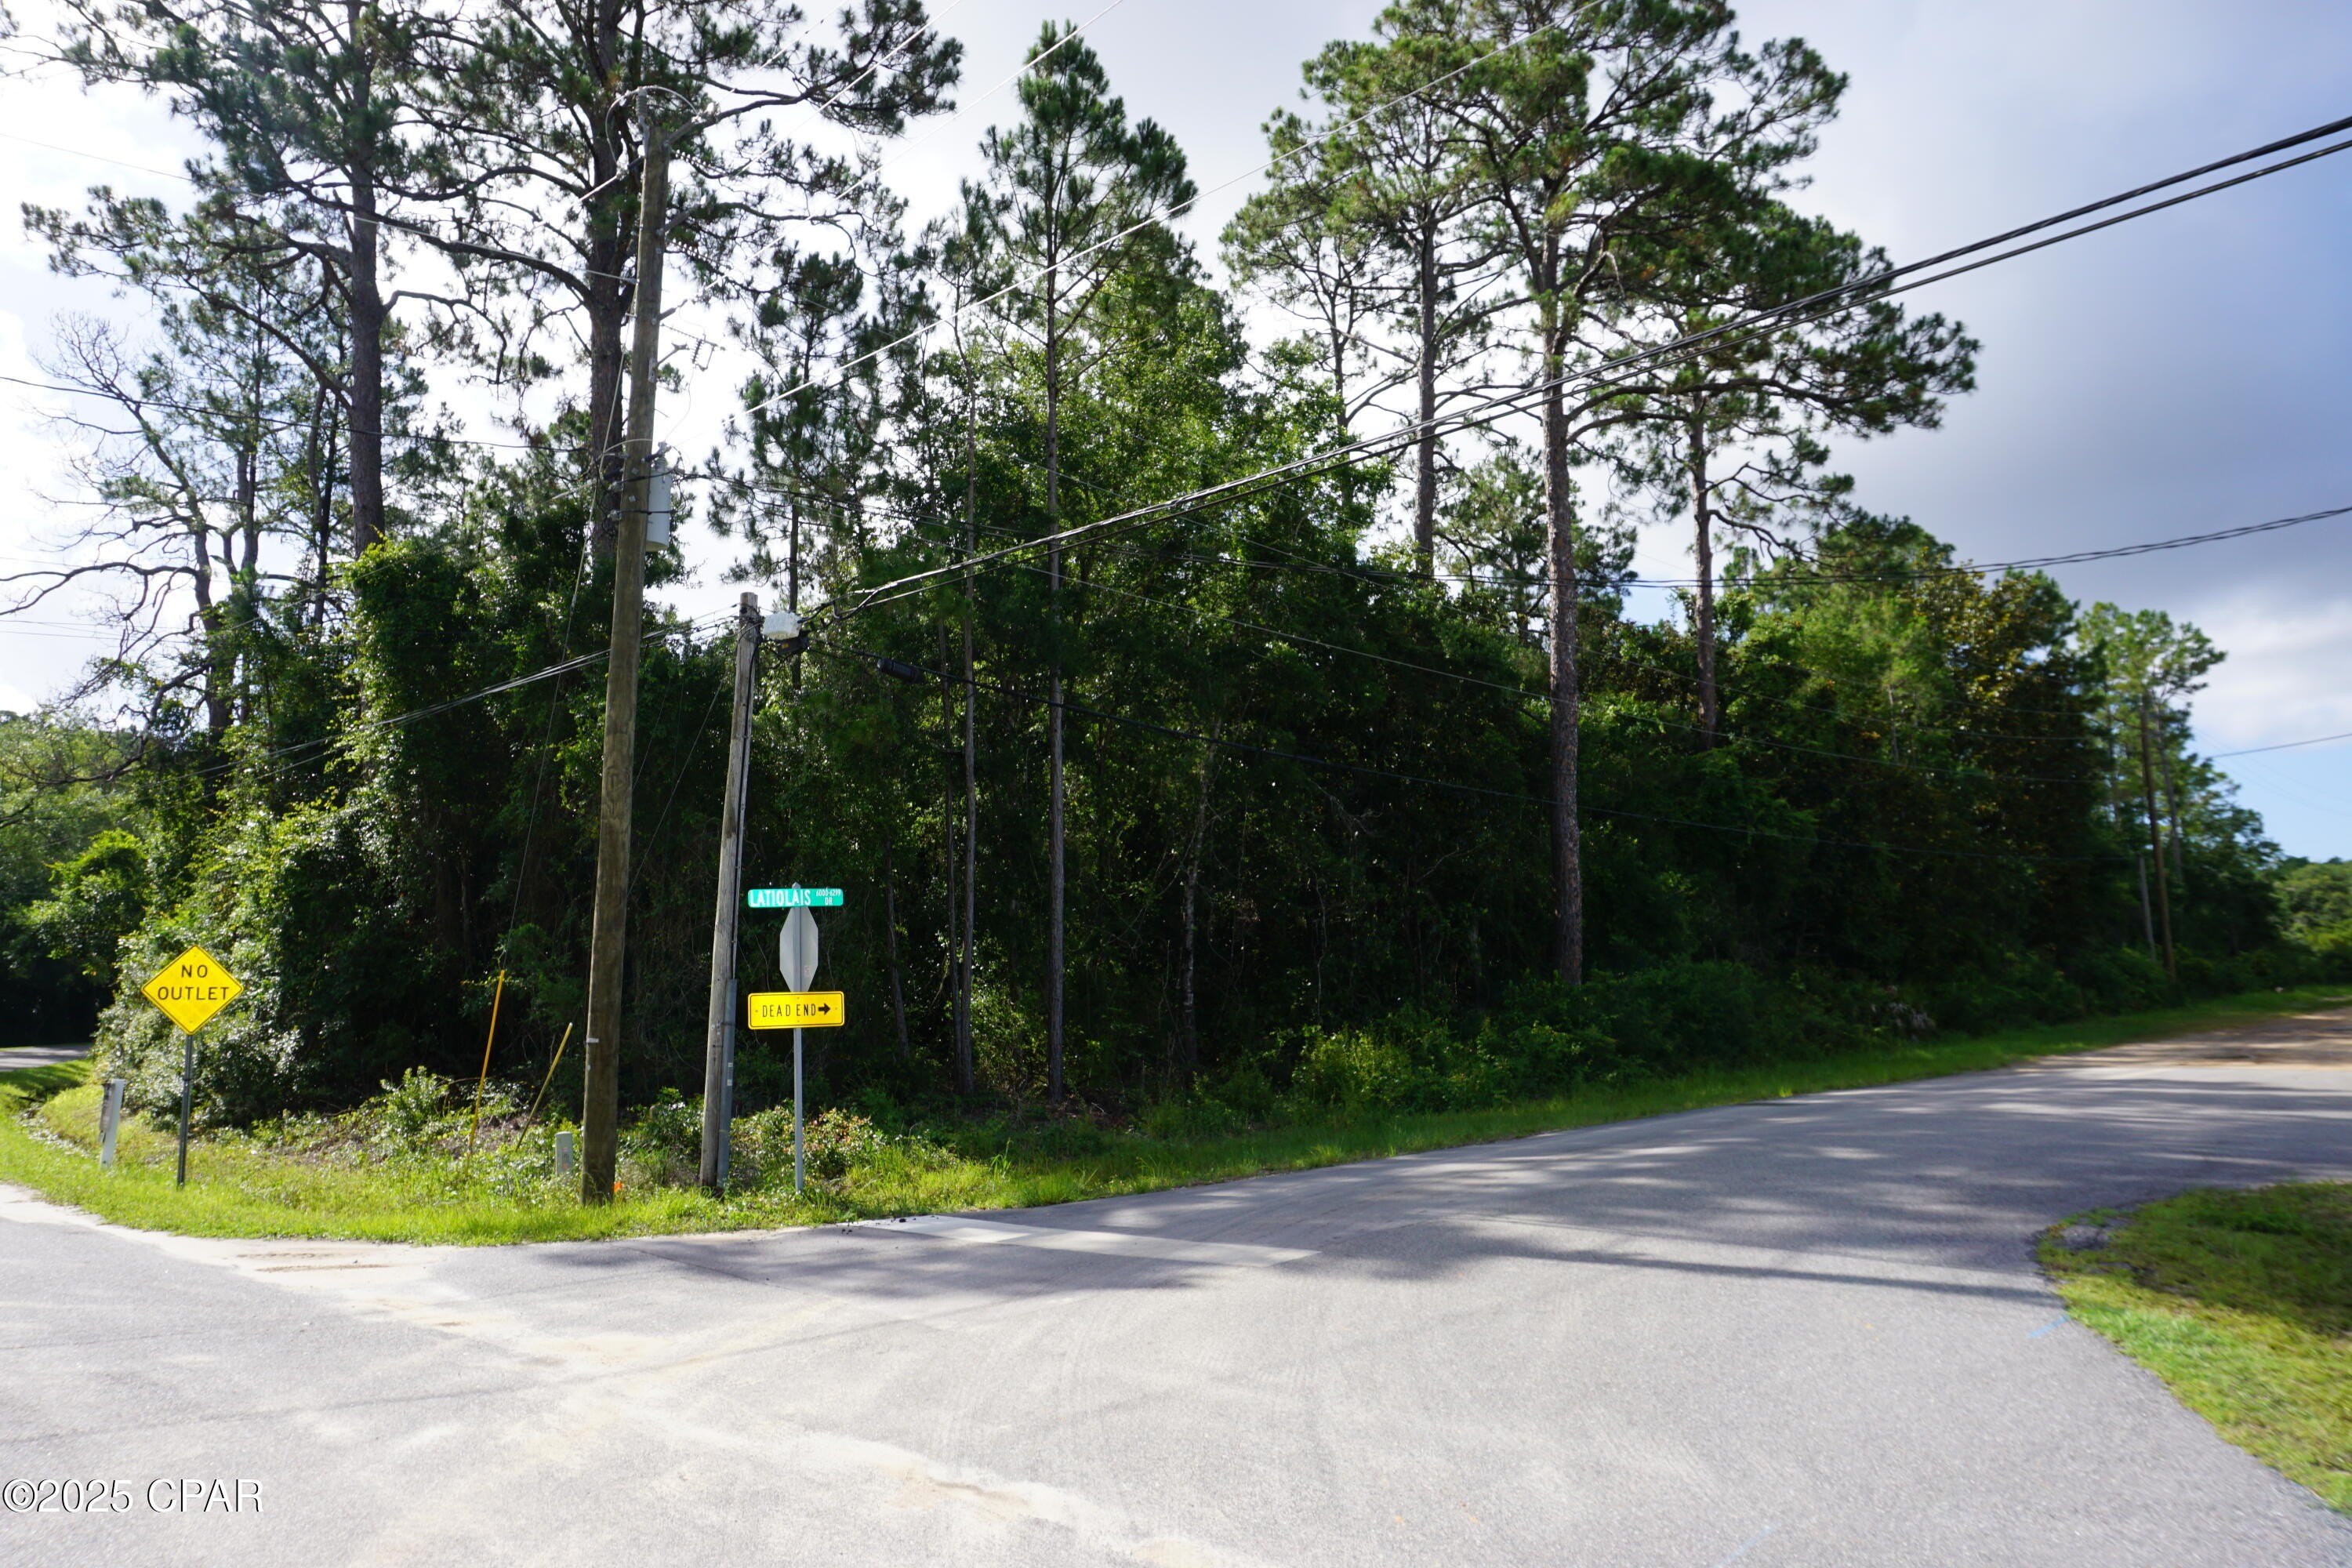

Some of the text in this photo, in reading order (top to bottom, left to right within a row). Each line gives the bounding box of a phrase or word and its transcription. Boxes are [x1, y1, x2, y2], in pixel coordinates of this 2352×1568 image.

[750, 889, 811, 907] LATIOLAIS
[824, 897, 833, 906] DR
[181, 964, 208, 978] NO
[158, 986, 230, 1000] OUTLET
[762, 1004, 816, 1018] DEAD END
